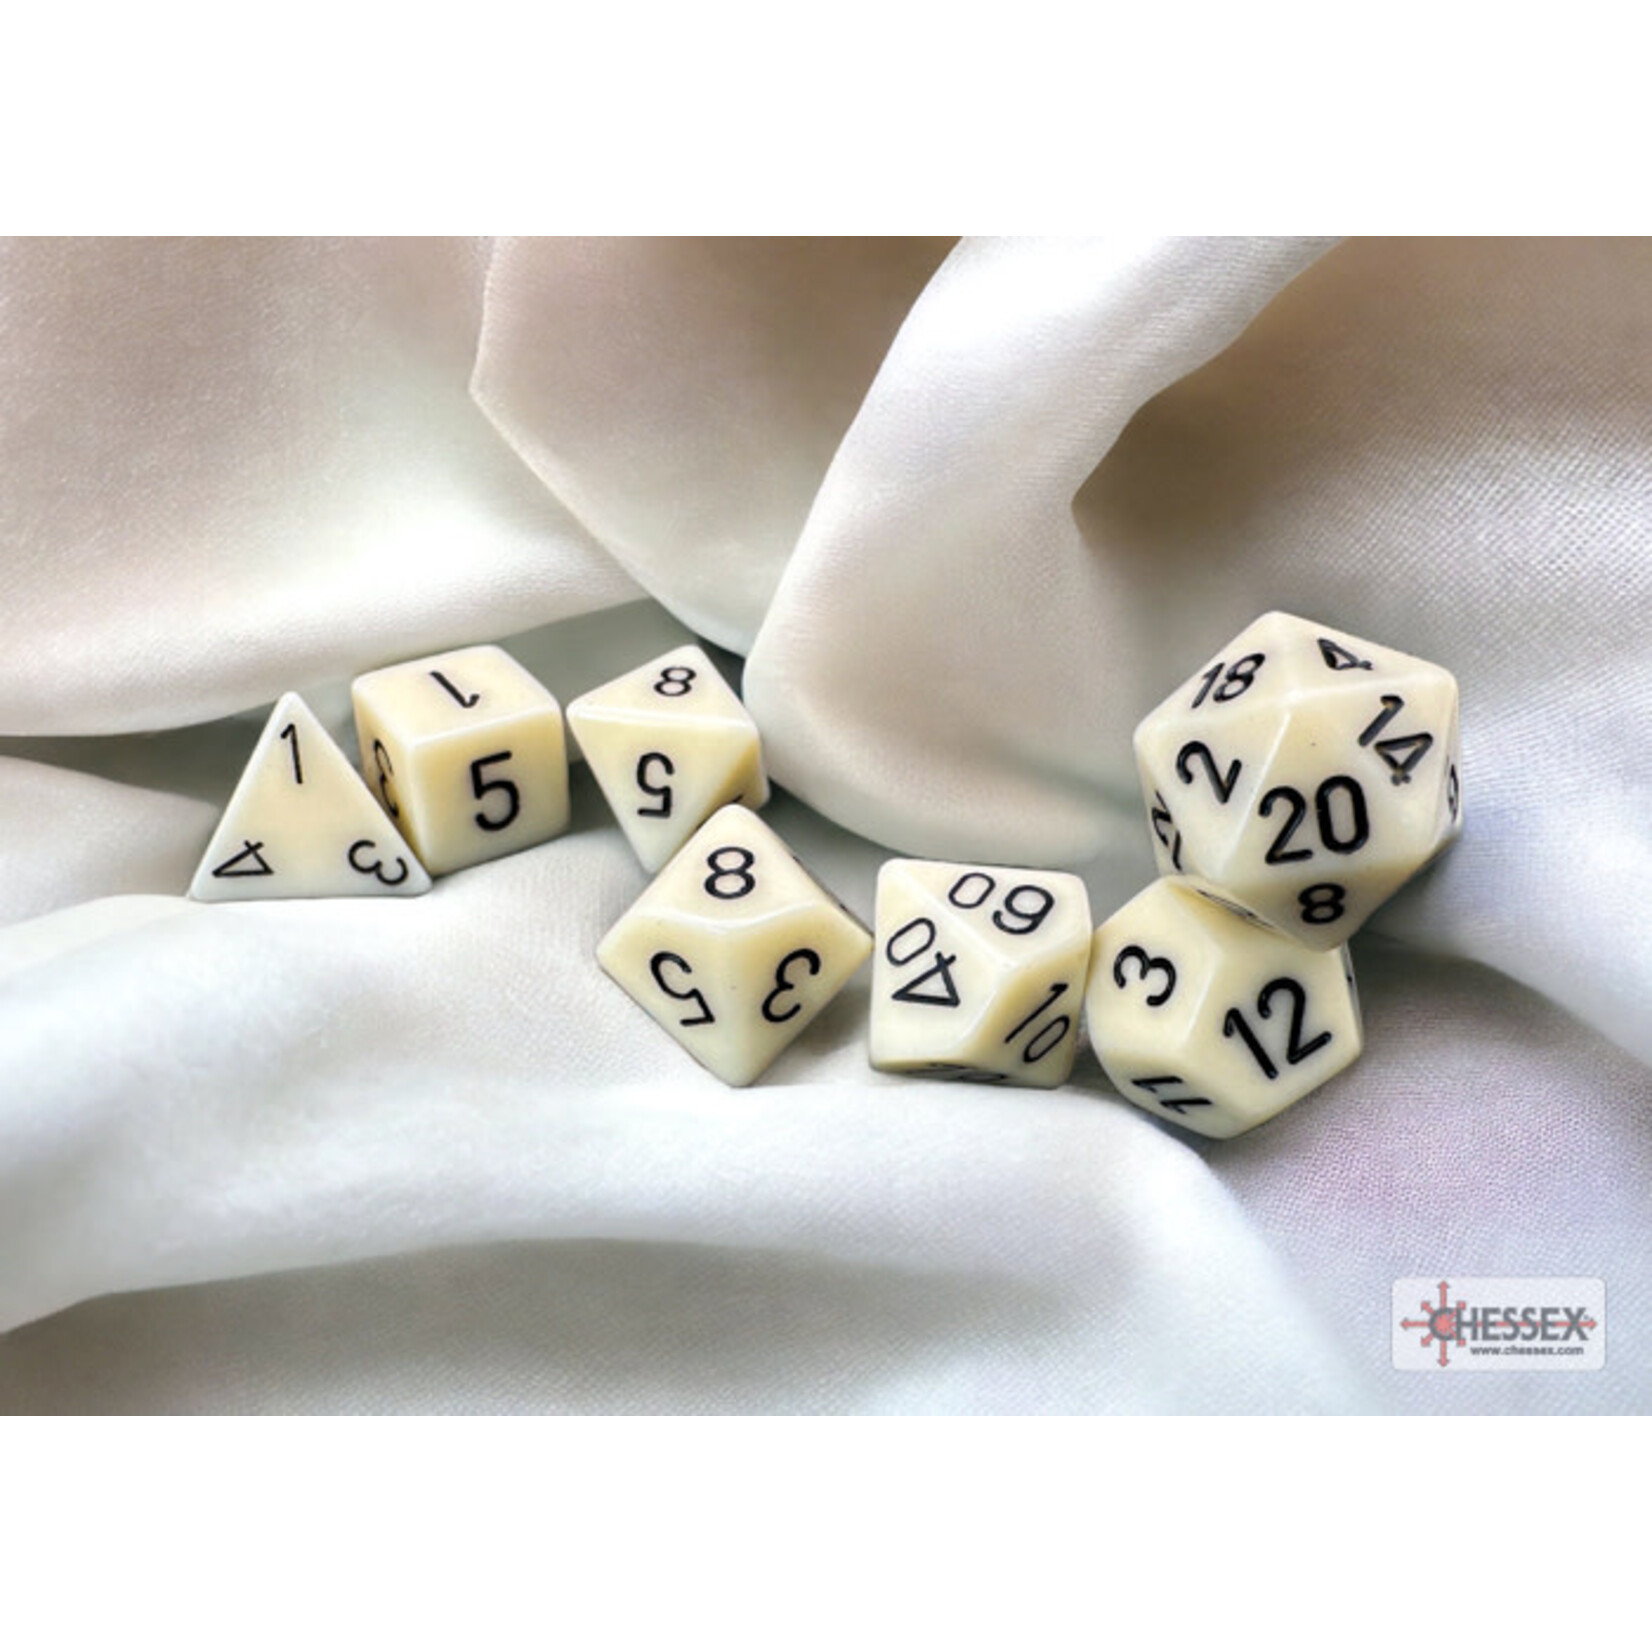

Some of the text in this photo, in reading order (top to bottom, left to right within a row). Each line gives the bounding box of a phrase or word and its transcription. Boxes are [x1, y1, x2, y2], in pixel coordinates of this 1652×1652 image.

[654, 667, 697, 696] 8
[1191, 653, 1266, 709] 18
[1317, 638, 1372, 671] 4
[430, 671, 480, 708] 1
[280, 723, 303, 785] 1
[1357, 694, 1434, 787] 14
[469, 750, 521, 832] 5
[636, 752, 675, 819] 5
[1175, 740, 1243, 805] 2
[1257, 774, 1371, 866] 20
[212, 840, 274, 878] 4
[347, 839, 409, 887] 3
[704, 846, 756, 900] 8
[1294, 877, 1349, 927] 8
[649, 951, 716, 1027] 5
[760, 947, 824, 1028] 3
[886, 917, 961, 1008] 40
[1113, 944, 1177, 1007] 3
[1001, 981, 1073, 1067] 10
[1221, 975, 1337, 1084] 12
[1127, 1074, 1215, 1119] 11
